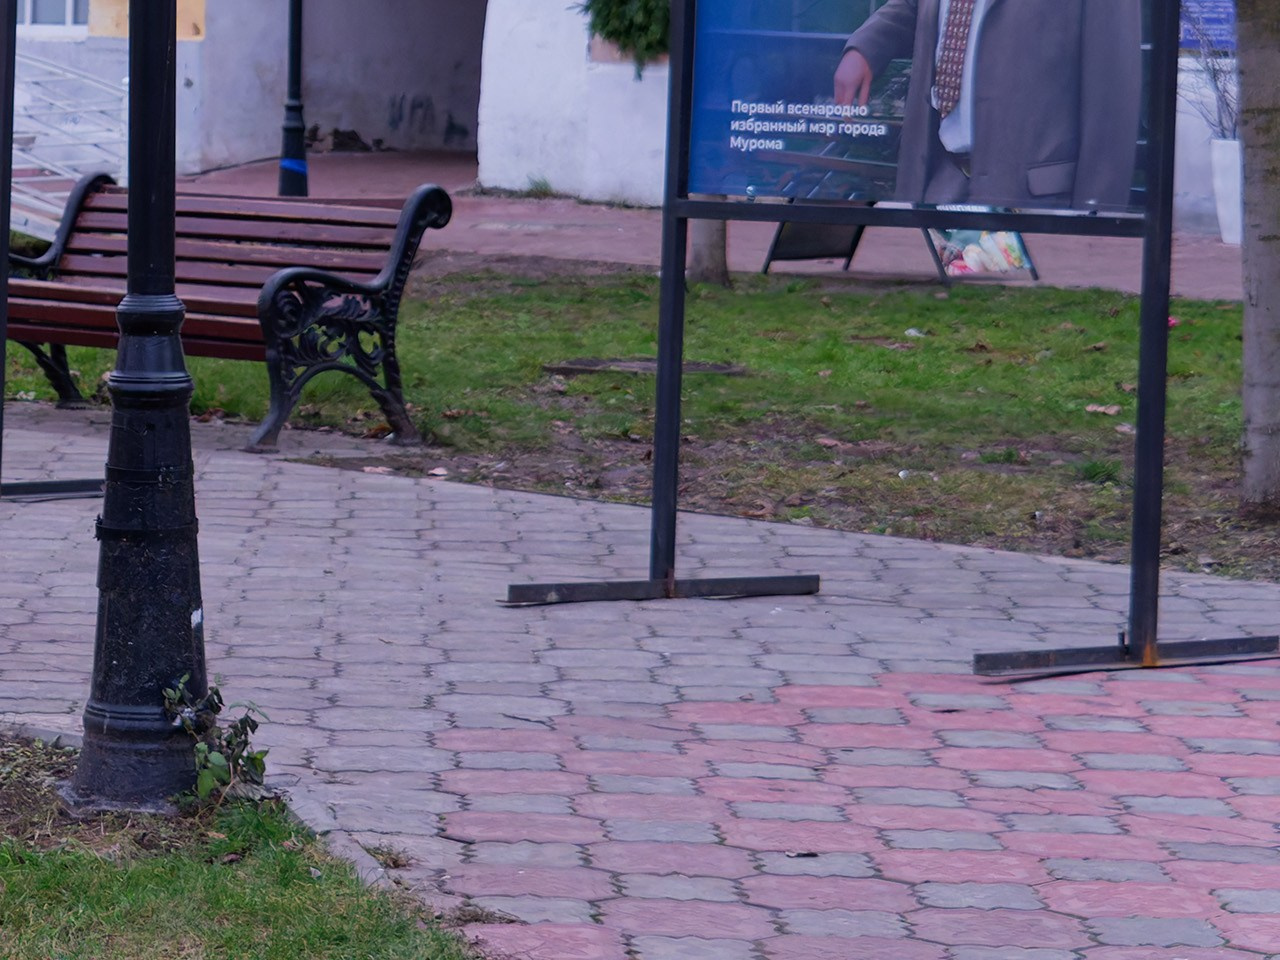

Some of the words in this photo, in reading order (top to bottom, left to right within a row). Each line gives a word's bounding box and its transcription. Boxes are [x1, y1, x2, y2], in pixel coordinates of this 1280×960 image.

[731, 100, 784, 116] Первый
[787, 102, 868, 118] всенародно
[730, 118, 806, 134] избранный
[810, 124, 835, 136] мэр
[838, 124, 887, 137] города
[730, 136, 784, 152] Мурома
